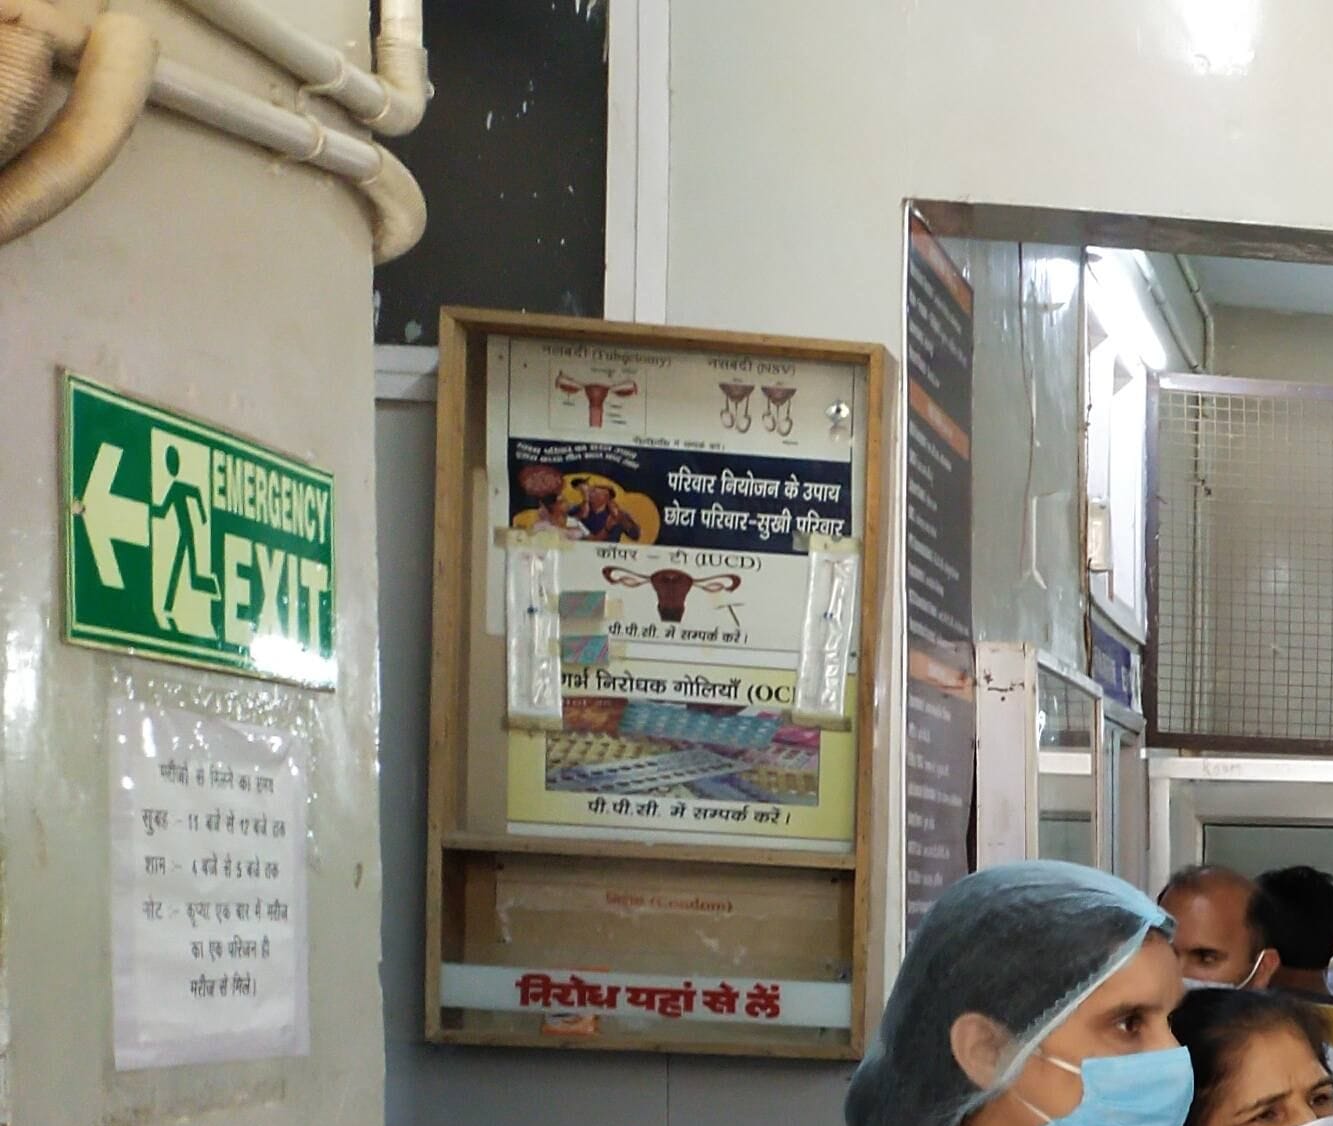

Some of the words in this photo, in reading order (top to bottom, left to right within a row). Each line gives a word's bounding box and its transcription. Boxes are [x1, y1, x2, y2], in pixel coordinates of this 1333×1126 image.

[212, 450, 328, 544] EMERGENCY
[668, 465, 717, 493] परिवार
[721, 468, 780, 498] नियोजन
[784, 473, 800, 499] के
[802, 482, 841, 503] उपाय
[664, 498, 696, 526] छोटा
[701, 502, 792, 540] परिवार-सुखी
[796, 509, 844, 536] परिवार
[695, 552, 763, 572] (IUCD)
[224, 533, 329, 655] EXIT
[596, 670, 667, 693] निरोधक
[747, 684, 796, 705] (OC
[515, 973, 621, 1009] निरोध
[625, 981, 696, 1018] यहां
[702, 982, 740, 1013] से
[745, 983, 781, 1018] लें
